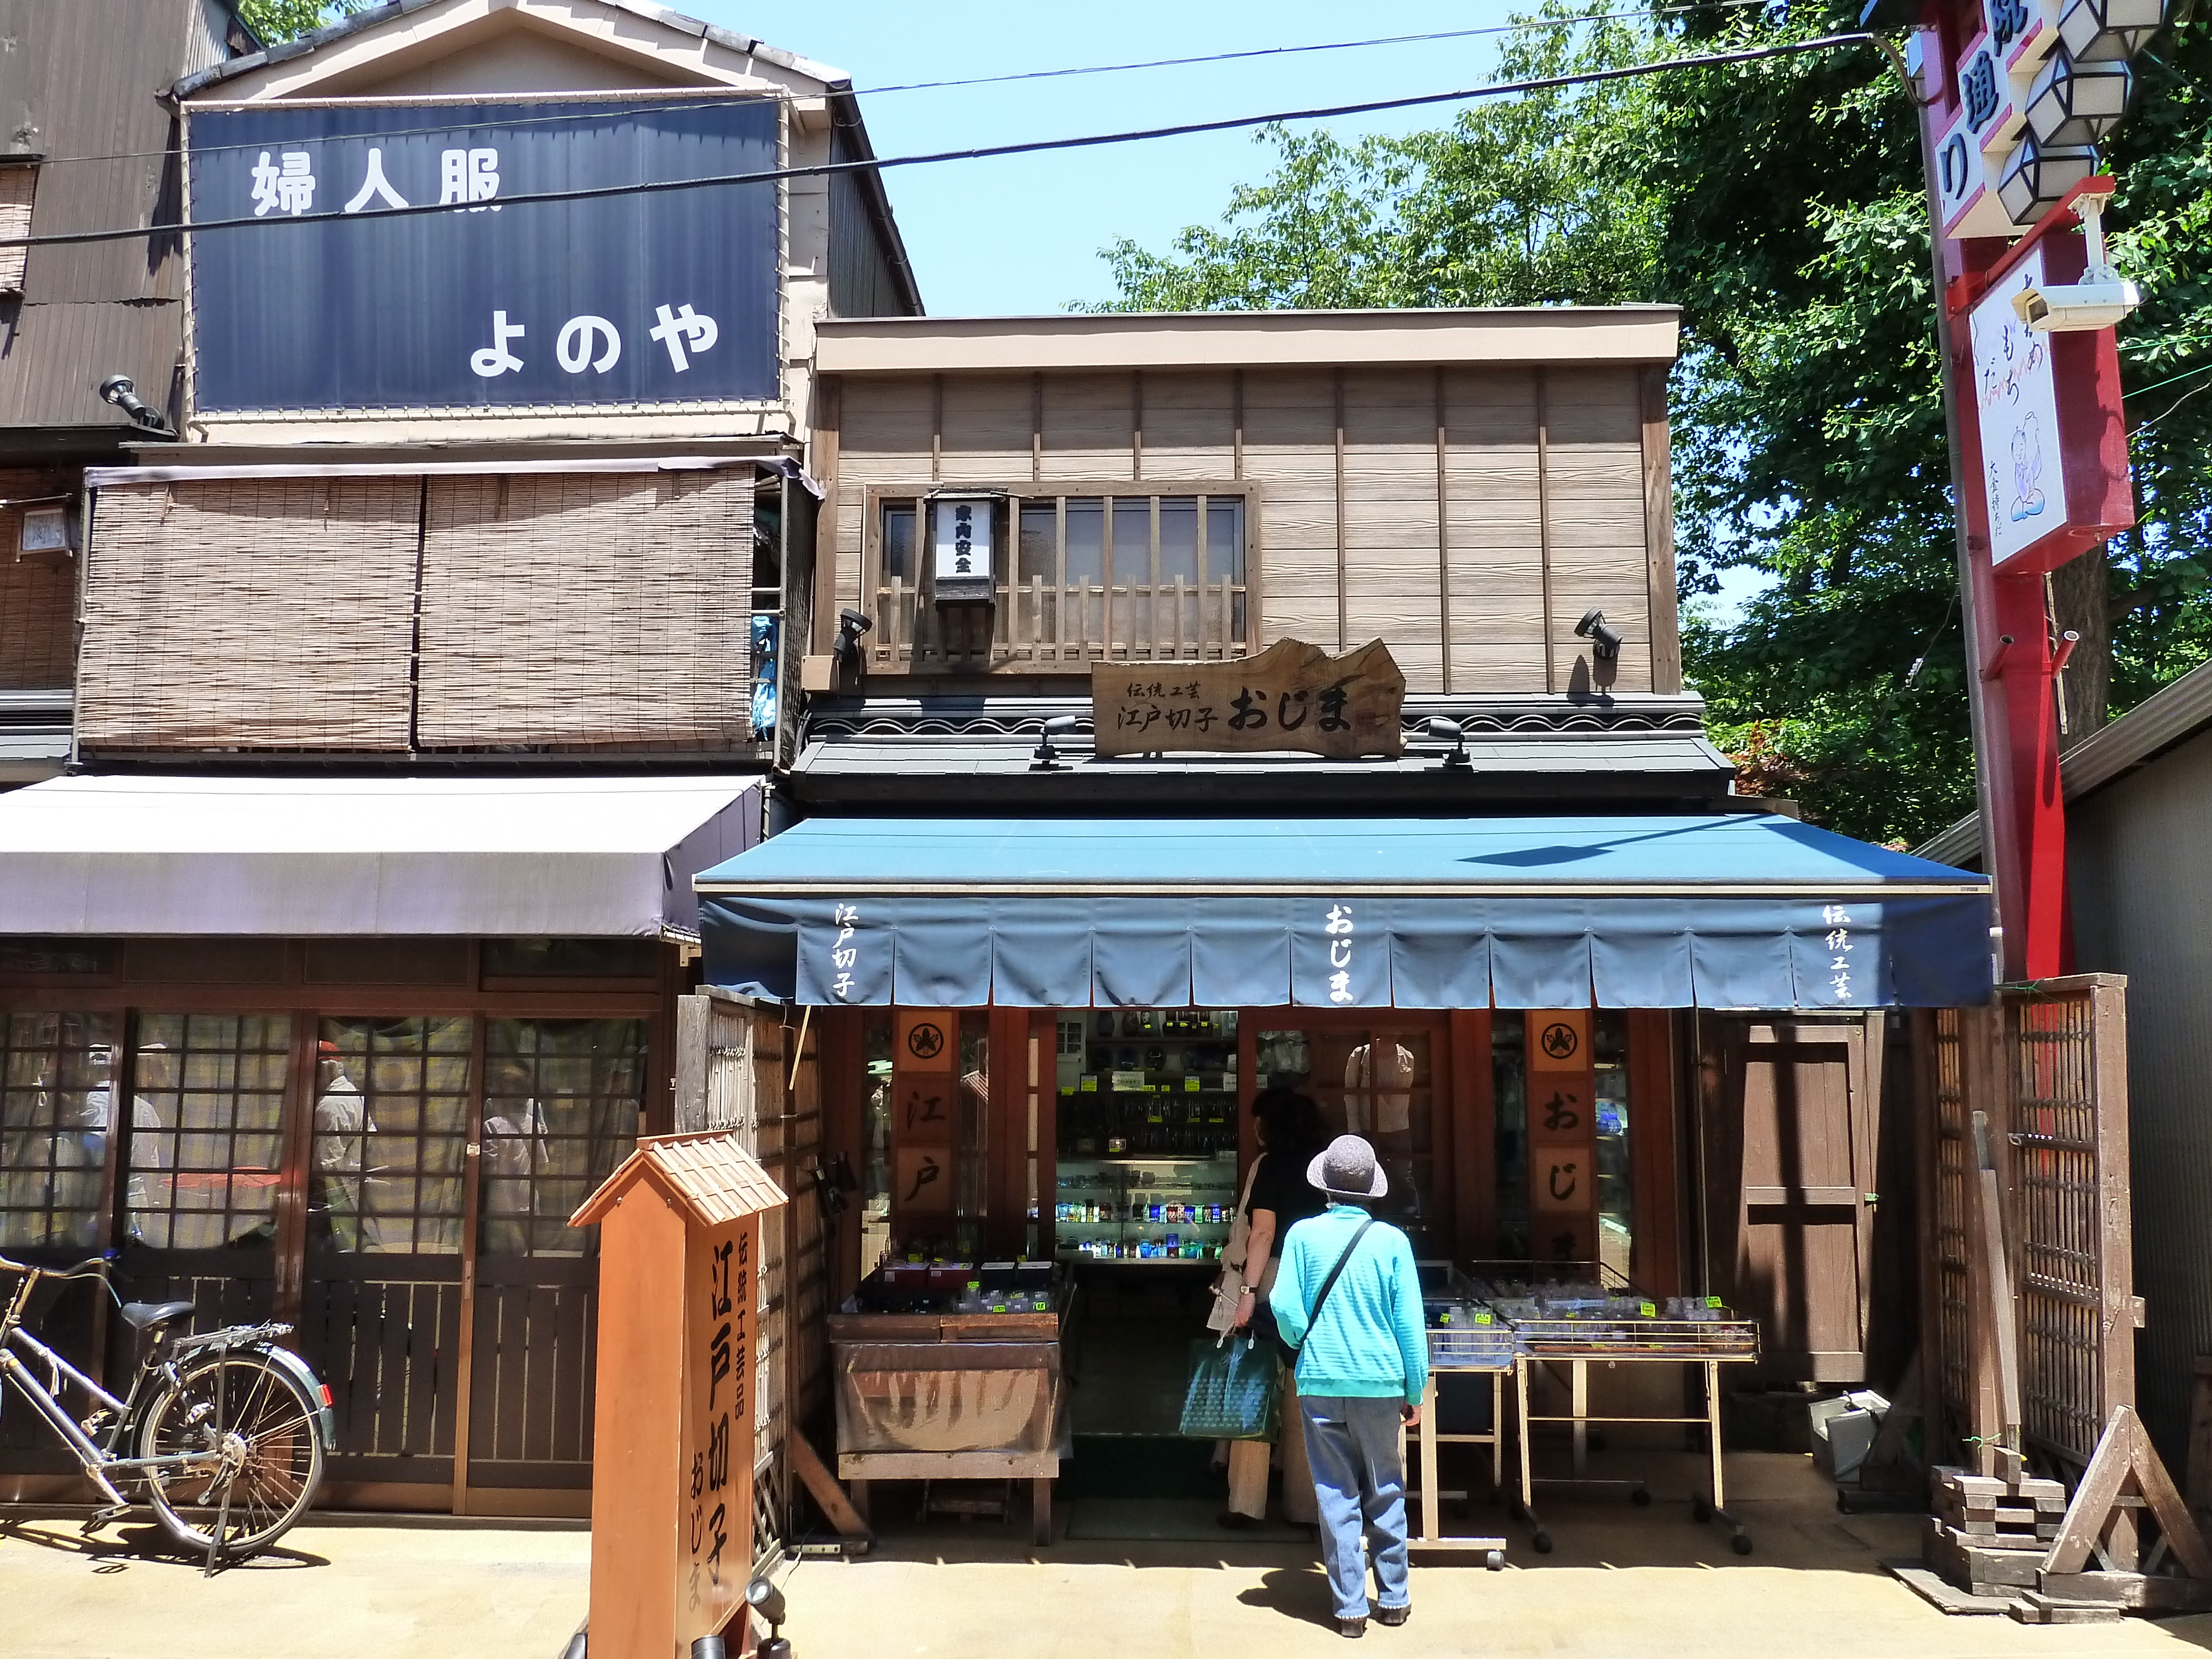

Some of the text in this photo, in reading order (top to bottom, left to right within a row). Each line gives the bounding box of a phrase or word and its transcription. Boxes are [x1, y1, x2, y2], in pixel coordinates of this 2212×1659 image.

[252, 148, 502, 216] 婦人服
[471, 302, 718, 378] よのや
[955, 504, 972, 574] 家内安全
[1118, 686, 1352, 733] 江戸切子 おじま
[1126, 682, 1201, 700] 伝統工芸
[832, 903, 859, 997] 江戸切子
[1325, 904, 1354, 1003] おじま
[1822, 905, 1854, 999] 伝統工芸
[734, 1231, 748, 1421] 伝統工芸品
[707, 1240, 734, 1585] 江戸切子
[689, 1451, 705, 1613] おじま
